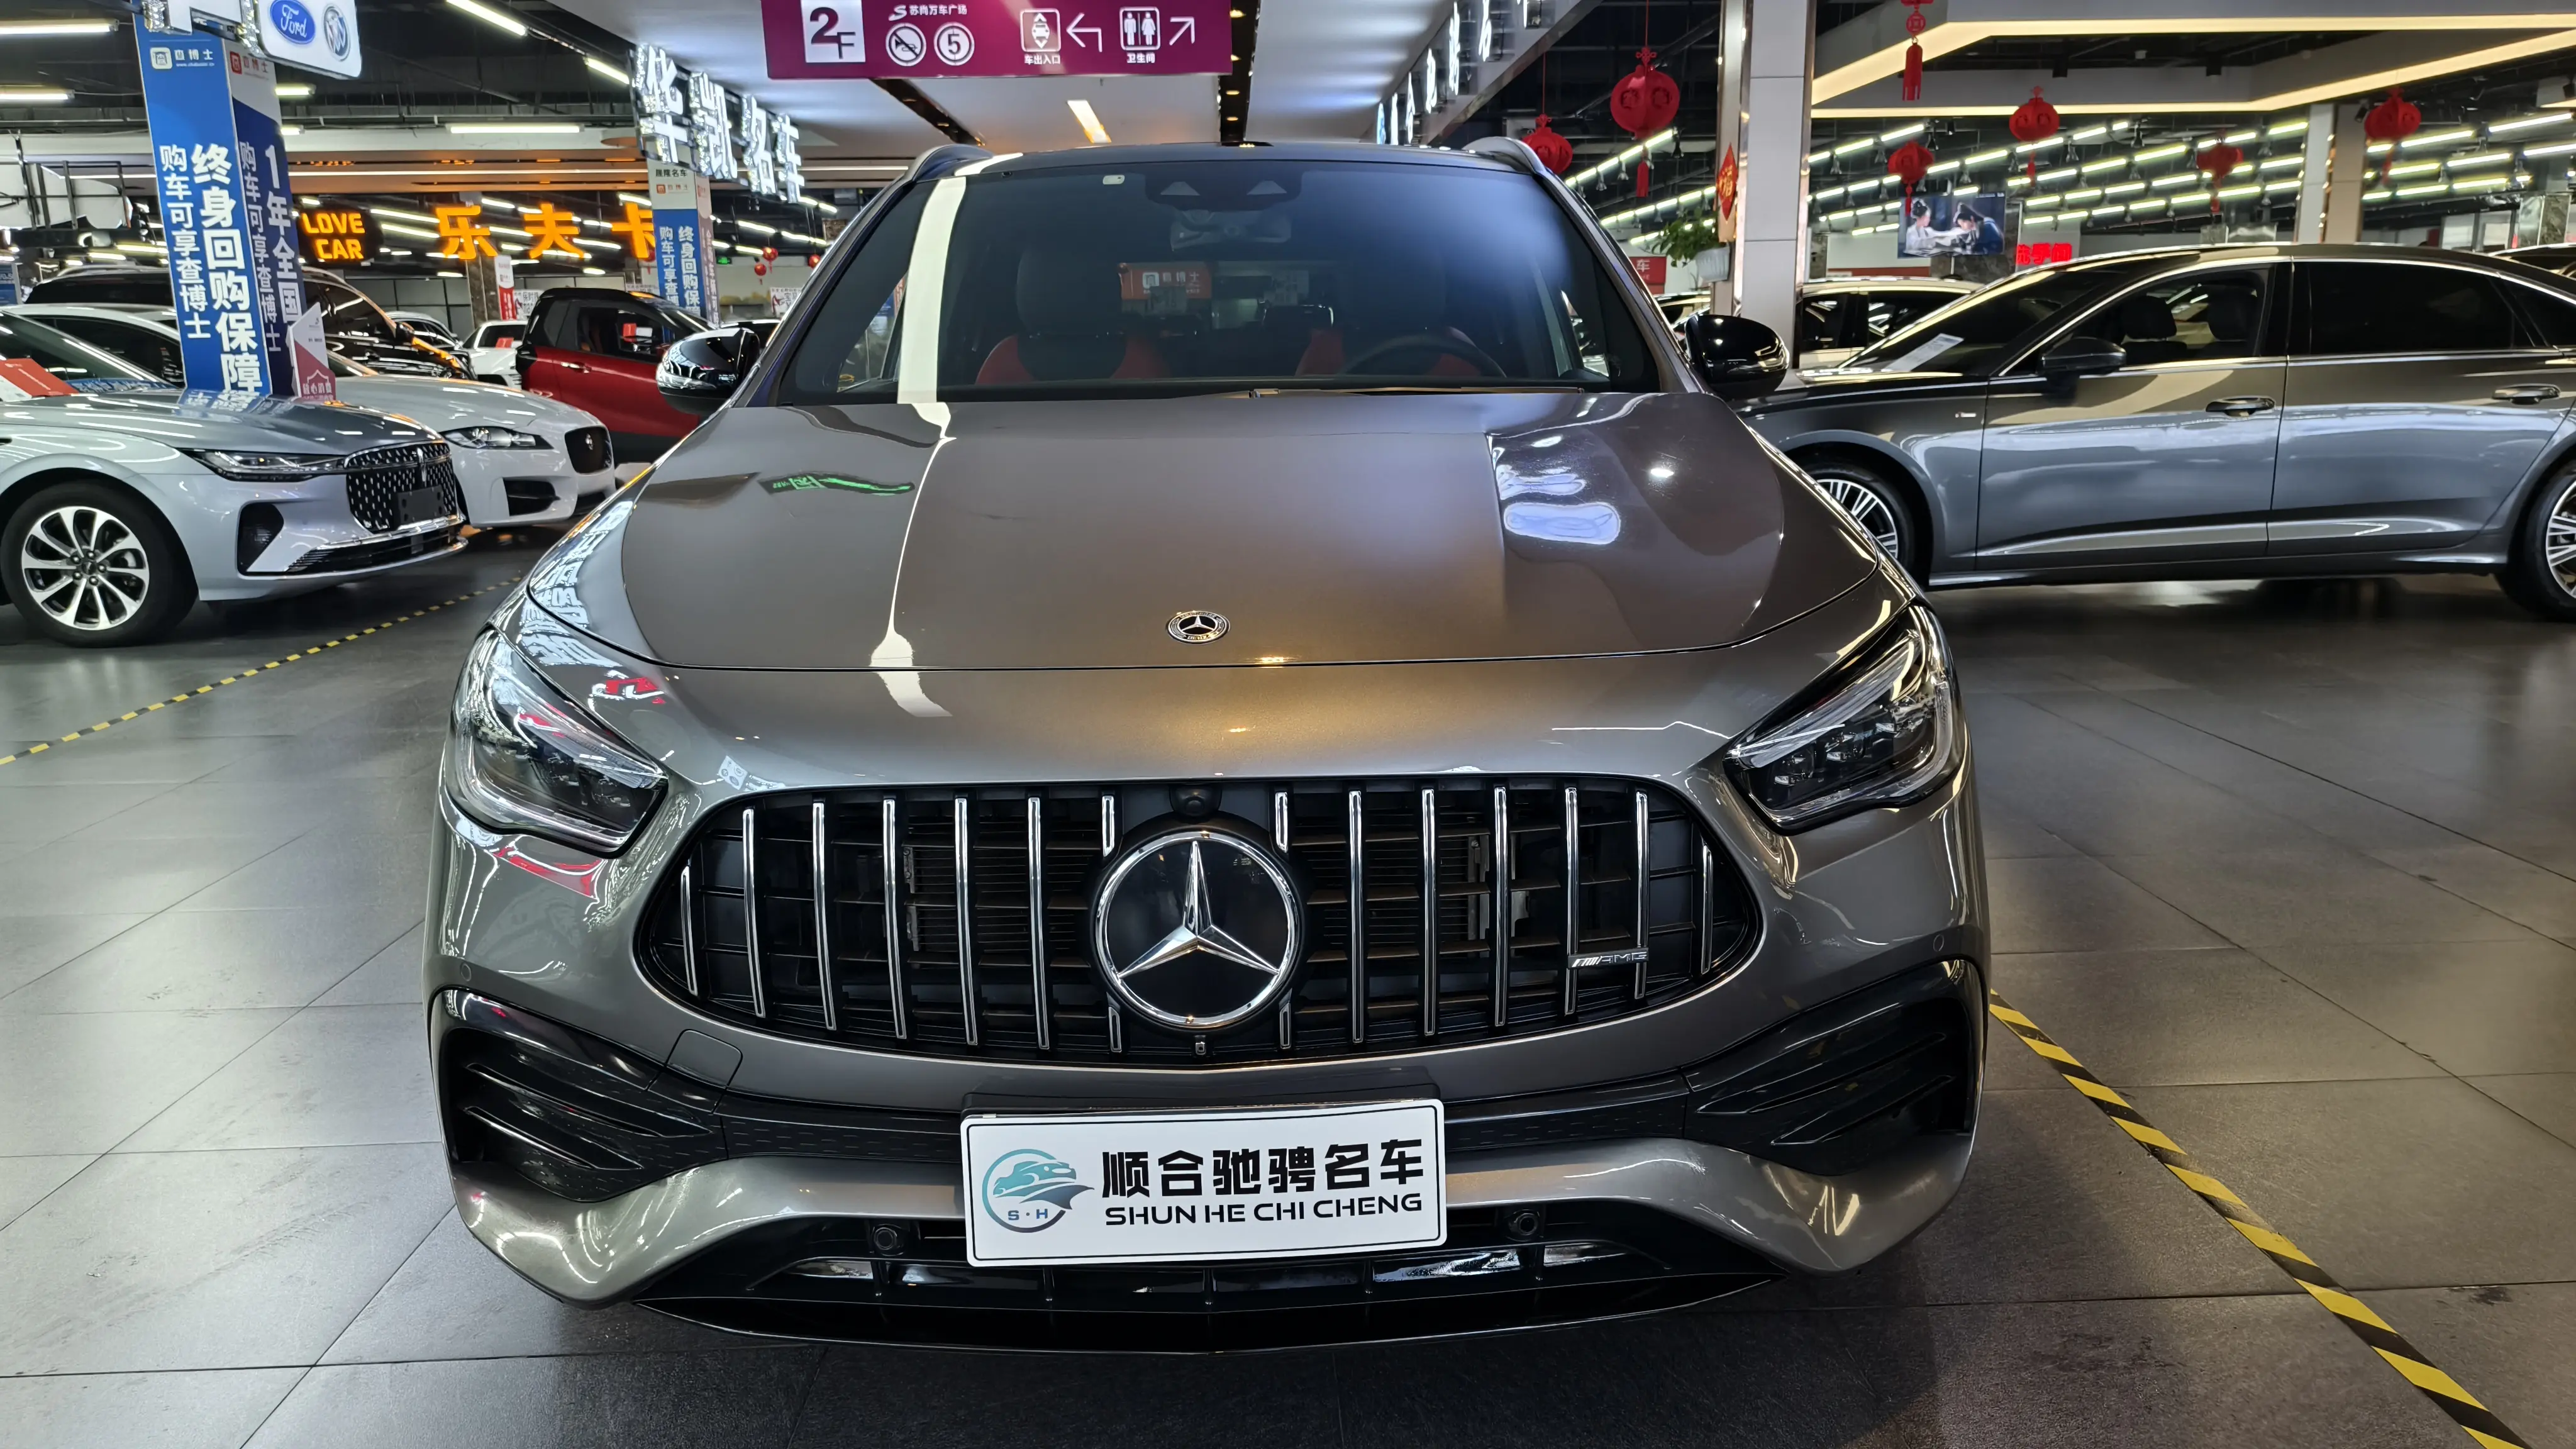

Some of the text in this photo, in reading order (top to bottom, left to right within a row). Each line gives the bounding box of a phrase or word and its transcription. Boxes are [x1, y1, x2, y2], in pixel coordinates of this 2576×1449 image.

[280, 4, 308, 38] Ford
[809, 6, 856, 59] 2F
[948, 33, 961, 55] 5
[1024, 53, 1061, 65] 车出入口
[1126, 52, 1156, 64] 卫生间
[633, 45, 806, 203] 华凯名车
[159, 143, 211, 338] 购车可享查博士
[302, 213, 365, 233] LOVE
[435, 201, 656, 260] 乐夫卡
[191, 143, 263, 392] 终身回购保障
[239, 142, 281, 352] 购车可享查博士
[316, 238, 364, 259] CAR
[1102, 1139, 1424, 1199] 顺合驰骋名车
[1105, 1192, 1423, 1226] SHUN HE CHI CHENG
